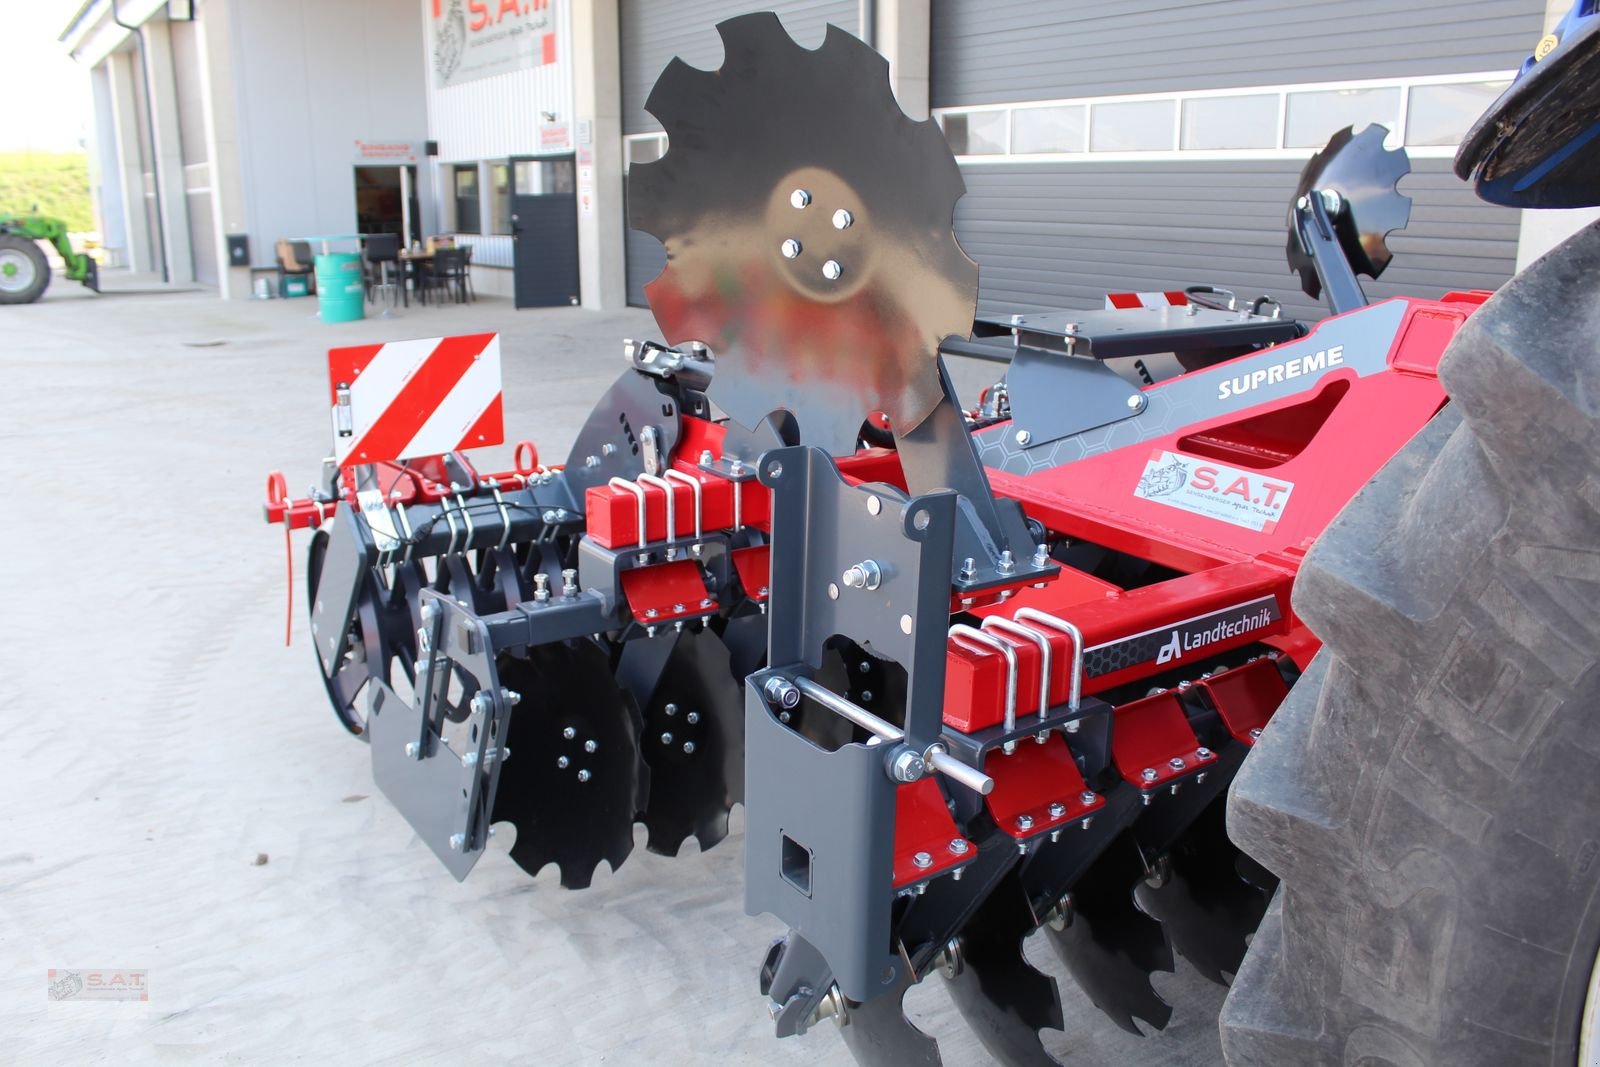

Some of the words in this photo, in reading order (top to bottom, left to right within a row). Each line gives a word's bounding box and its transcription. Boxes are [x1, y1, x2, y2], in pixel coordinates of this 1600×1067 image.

[1218, 345, 1344, 400] SUPREME
[1190, 466, 1288, 510] S.A.T.
[1184, 608, 1271, 651] Landtechnik
